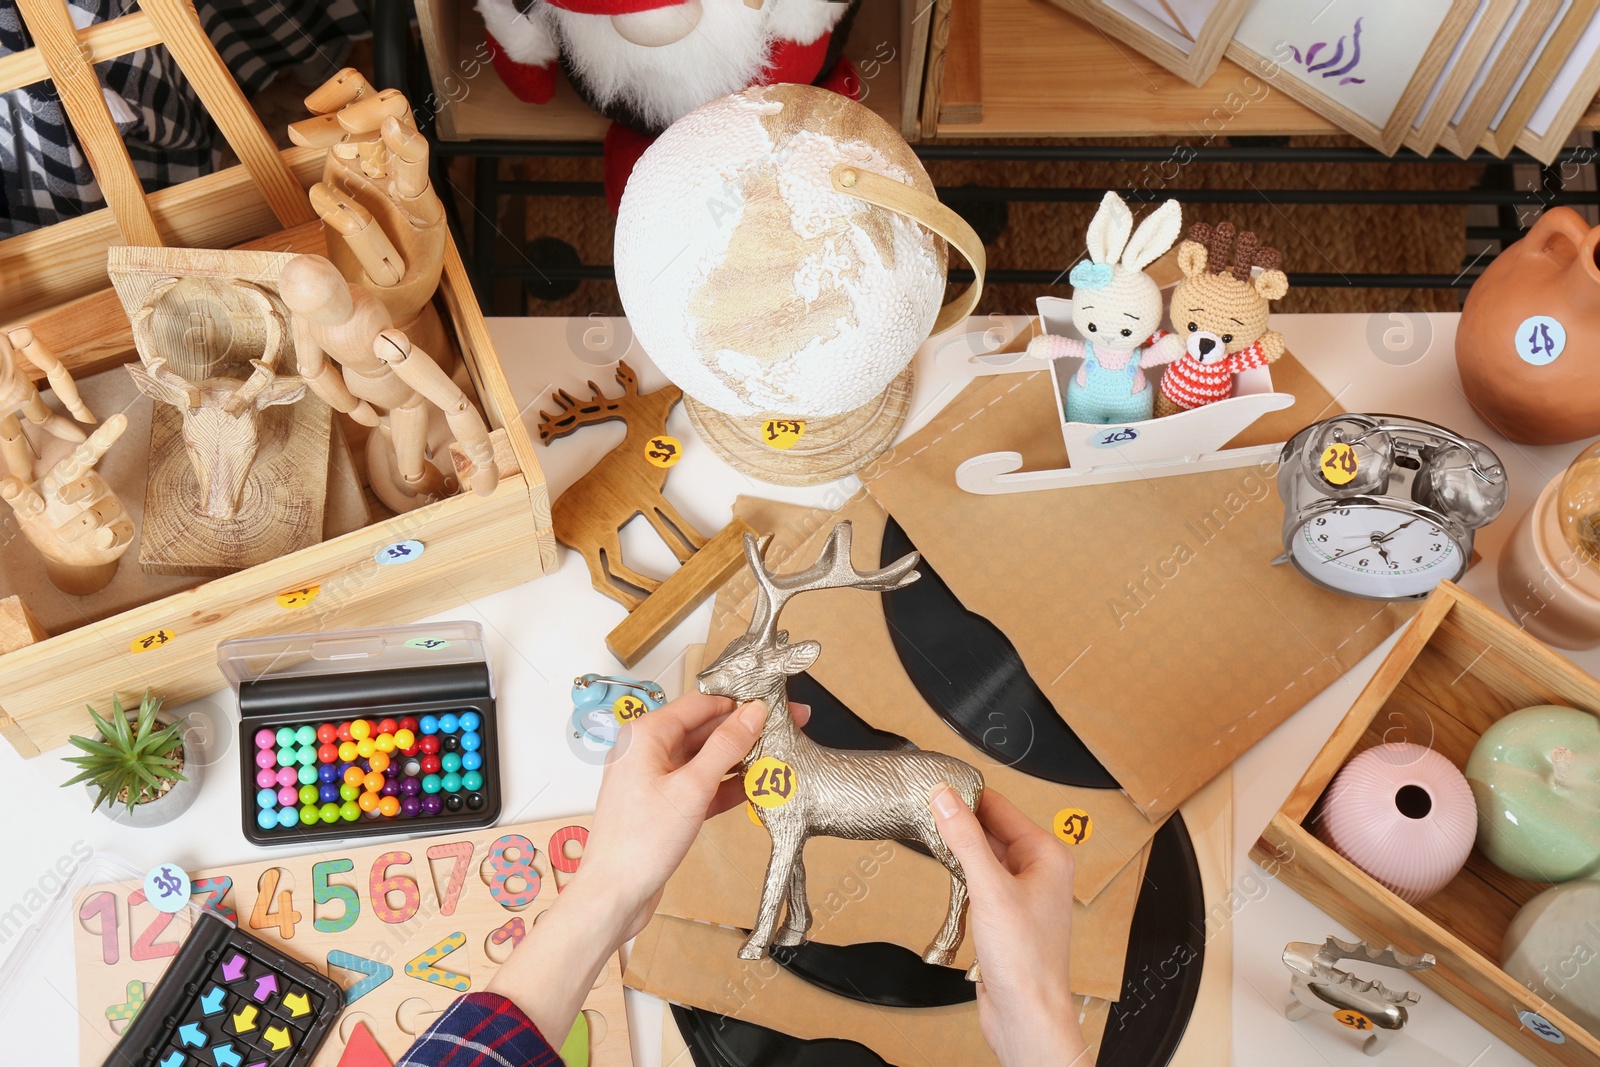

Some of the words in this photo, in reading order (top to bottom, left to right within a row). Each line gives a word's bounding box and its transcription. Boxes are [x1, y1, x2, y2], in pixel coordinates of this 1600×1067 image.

[1316, 518, 1327, 527] 9
[1317, 534, 1329, 543] 8
[1430, 543, 1442, 552] 3
[1335, 548, 1344, 557] 7
[1359, 558, 1370, 567] 6
[1412, 555, 1423, 564] 4
[1388, 561, 1399, 570] 5
[153, 867, 182, 898] 3$
[249, 867, 302, 939] 4
[312, 858, 360, 933] 5
[369, 851, 420, 923] 6
[426, 841, 474, 916] 7
[488, 834, 541, 907] 8
